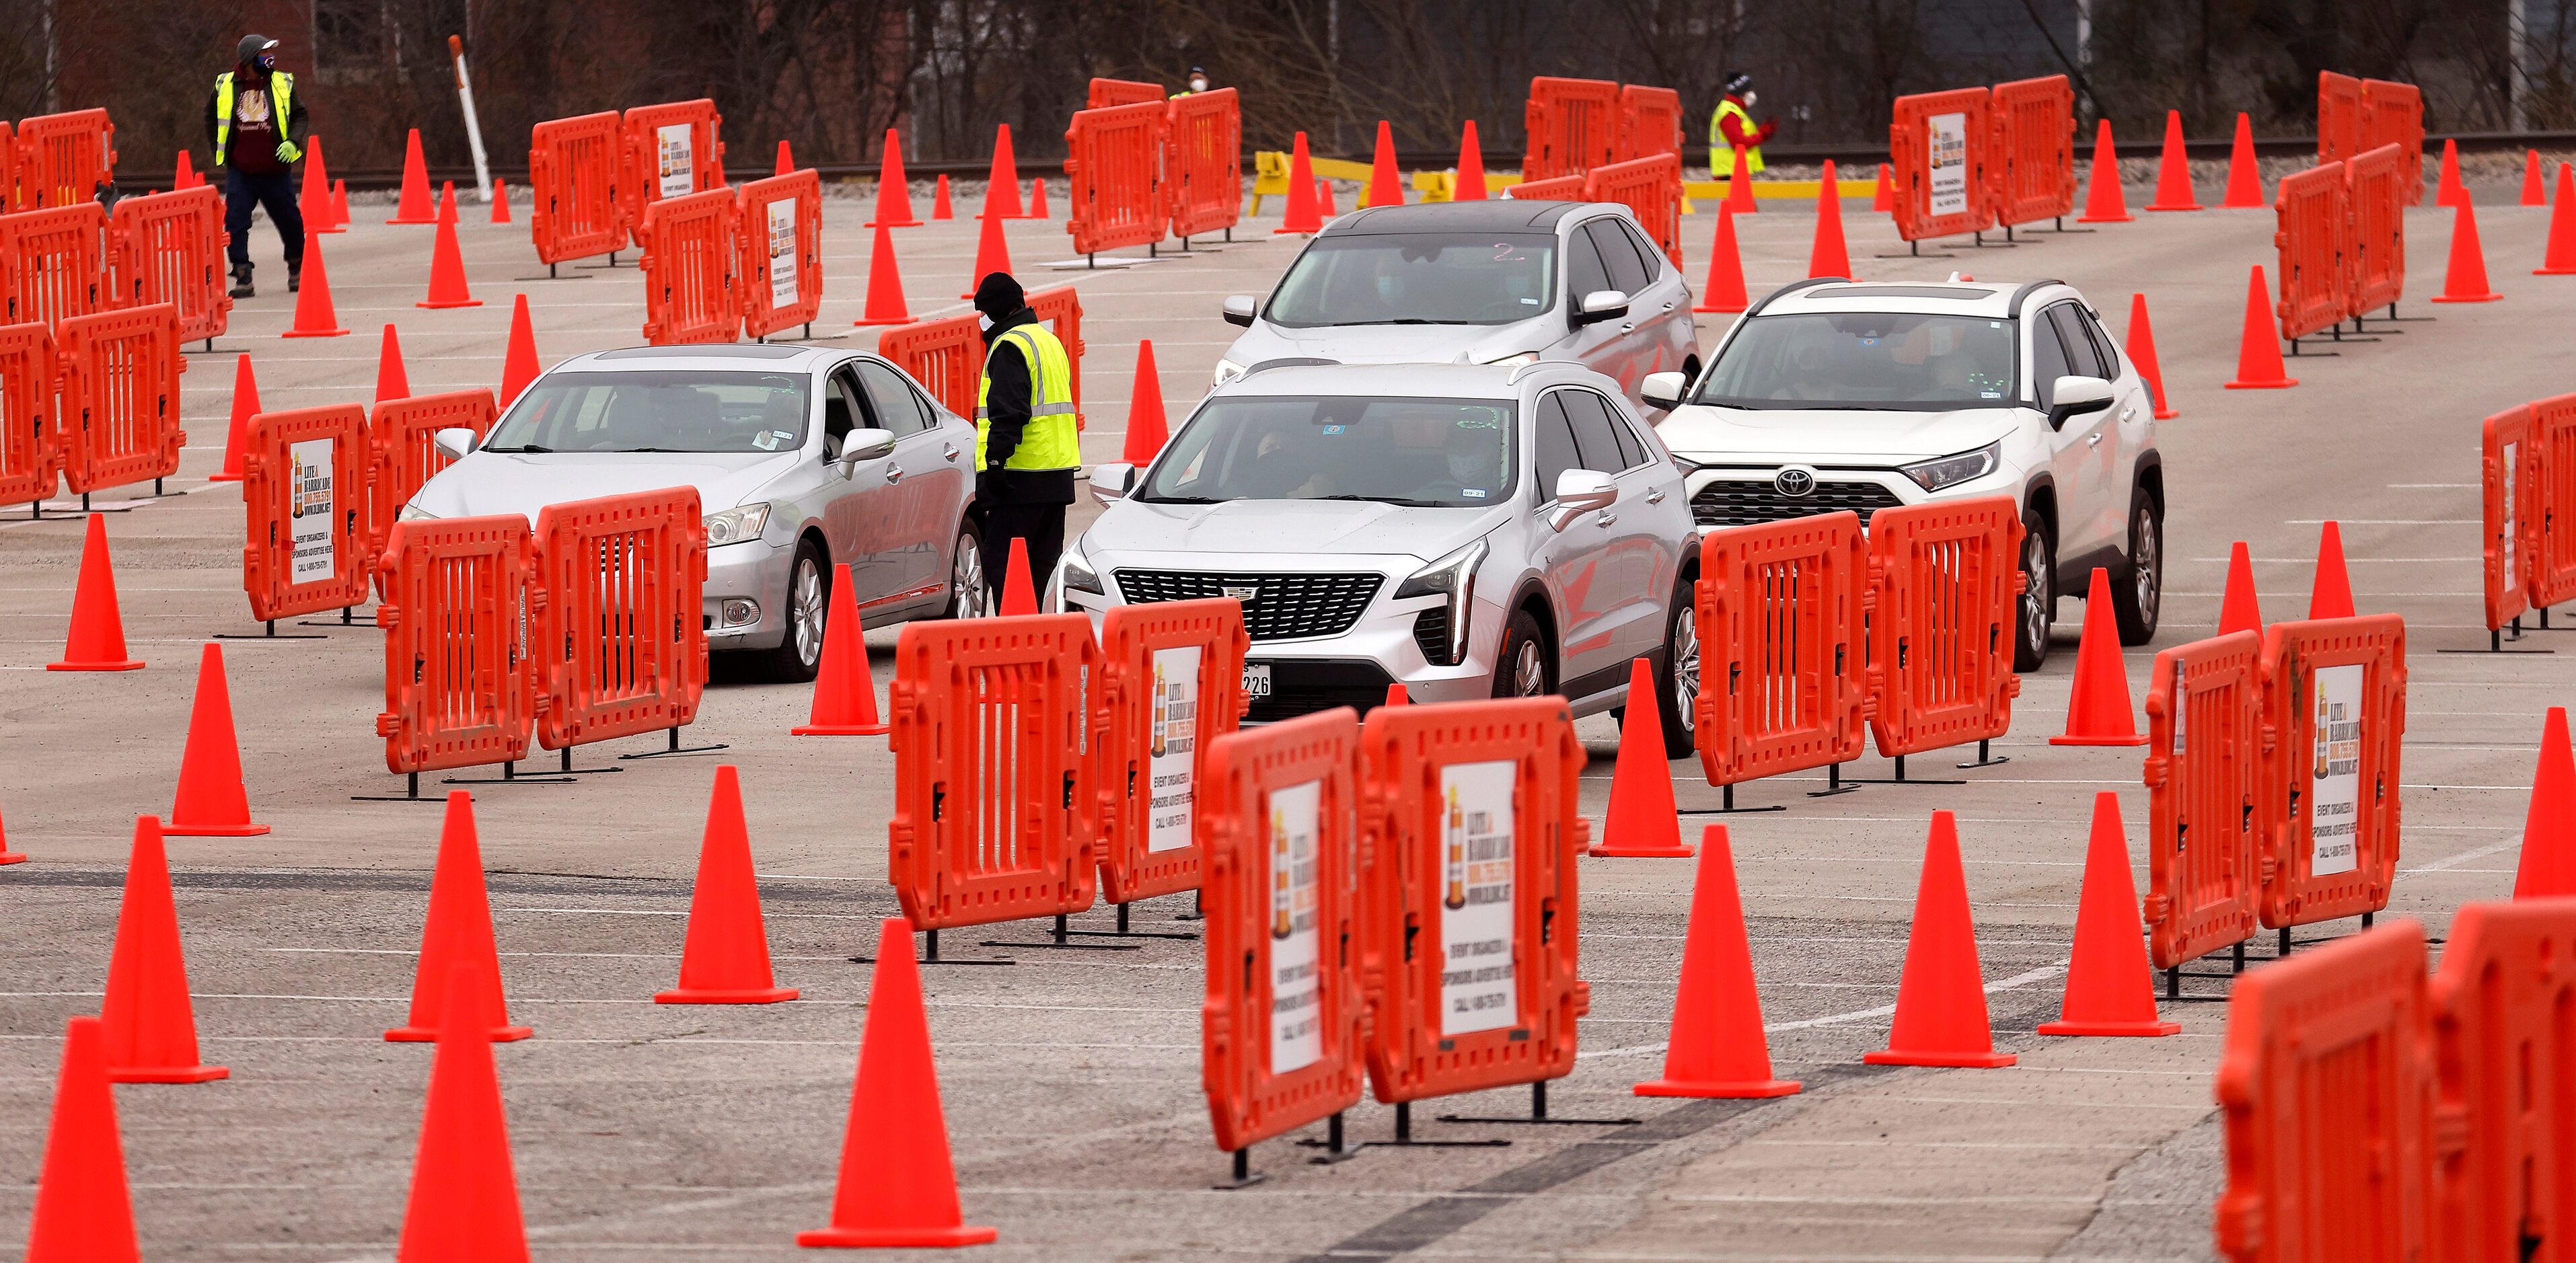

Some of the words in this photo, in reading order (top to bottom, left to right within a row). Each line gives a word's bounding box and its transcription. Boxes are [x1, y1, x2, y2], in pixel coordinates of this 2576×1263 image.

[1494, 243, 1526, 262] 2
[304, 465, 315, 479] LITE
[304, 477, 331, 493] BARRICADE
[296, 535, 306, 544] EVENT
[307, 532, 325, 543] ORGANIZERS
[291, 548, 308, 559] SPONSORS
[308, 546, 324, 556] ADVERTISE
[325, 545, 333, 553] HERE
[298, 564, 307, 572] CALL
